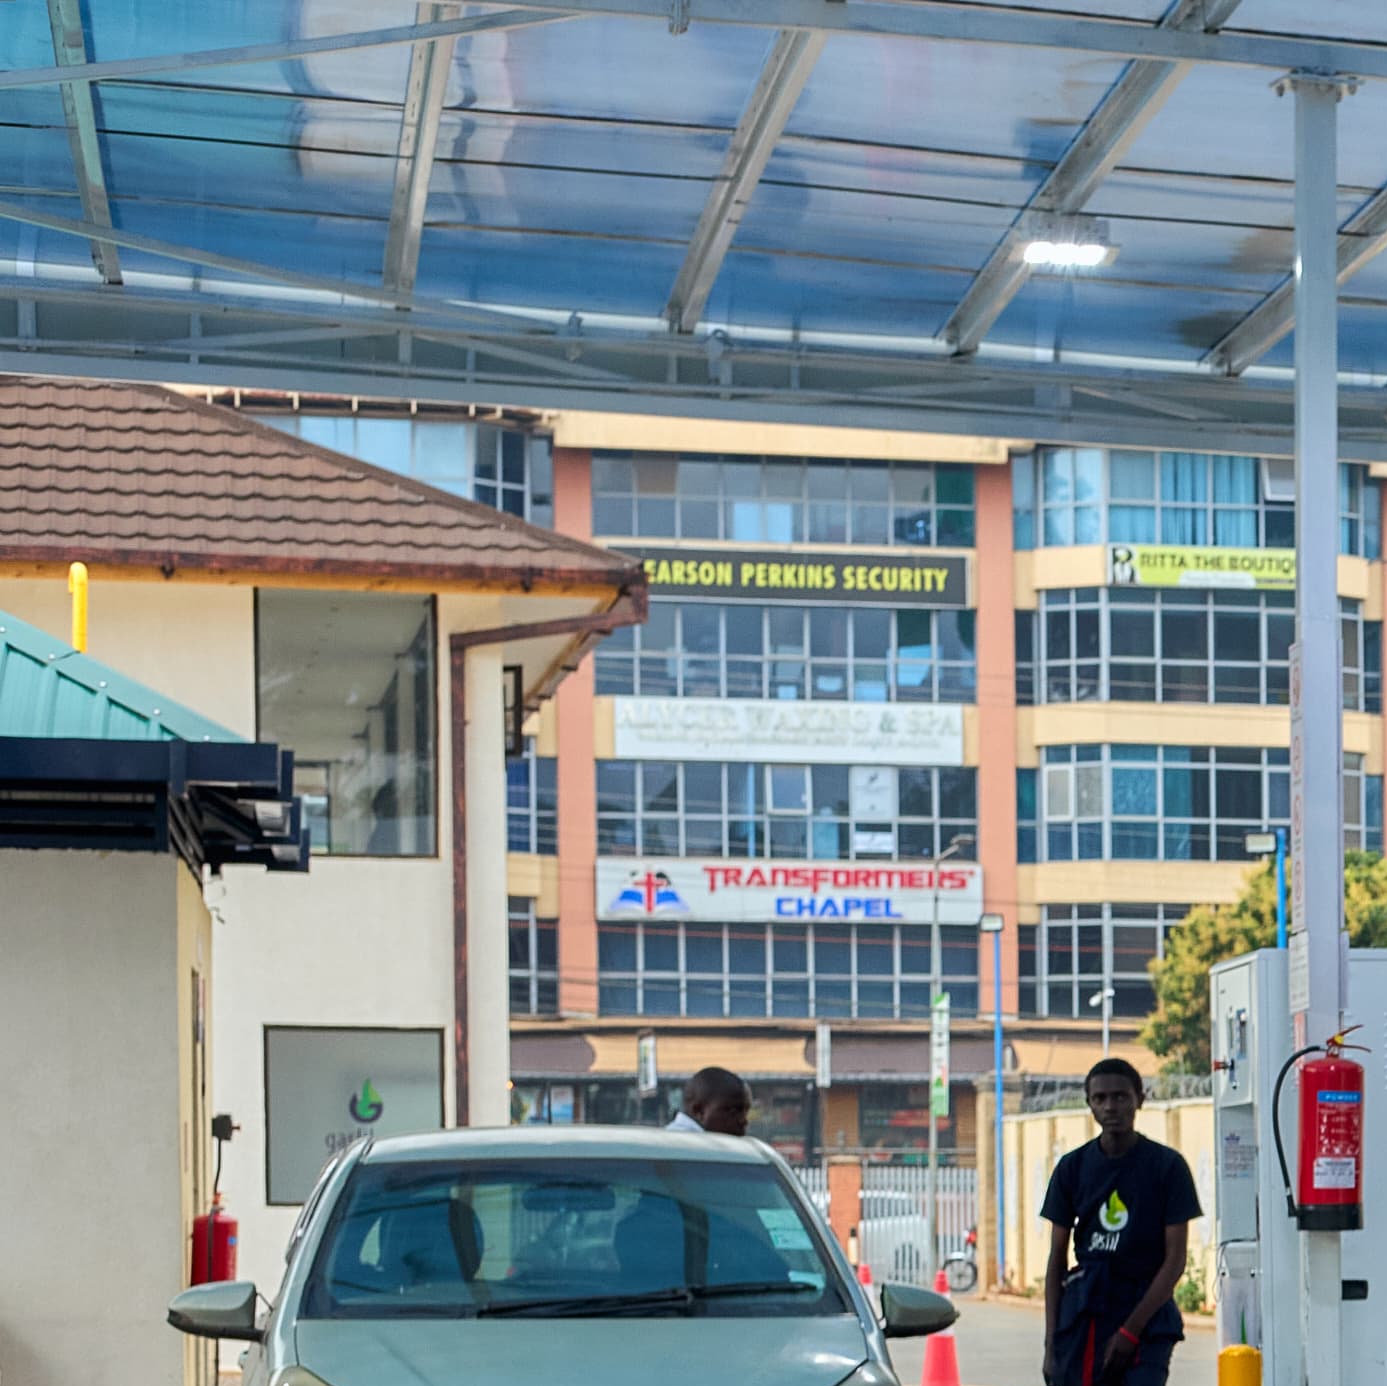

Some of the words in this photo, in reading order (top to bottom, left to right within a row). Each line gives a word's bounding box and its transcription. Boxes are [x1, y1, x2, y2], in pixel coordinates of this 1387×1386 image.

[1140, 553, 1185, 568] RITTA
[1193, 555, 1223, 569] THE
[1229, 556, 1296, 574] BOUTIQ
[644, 560, 733, 586] EARSON
[741, 562, 836, 589] PERKINS
[842, 566, 948, 592] SECURITY
[775, 897, 903, 918] CHAPEL
